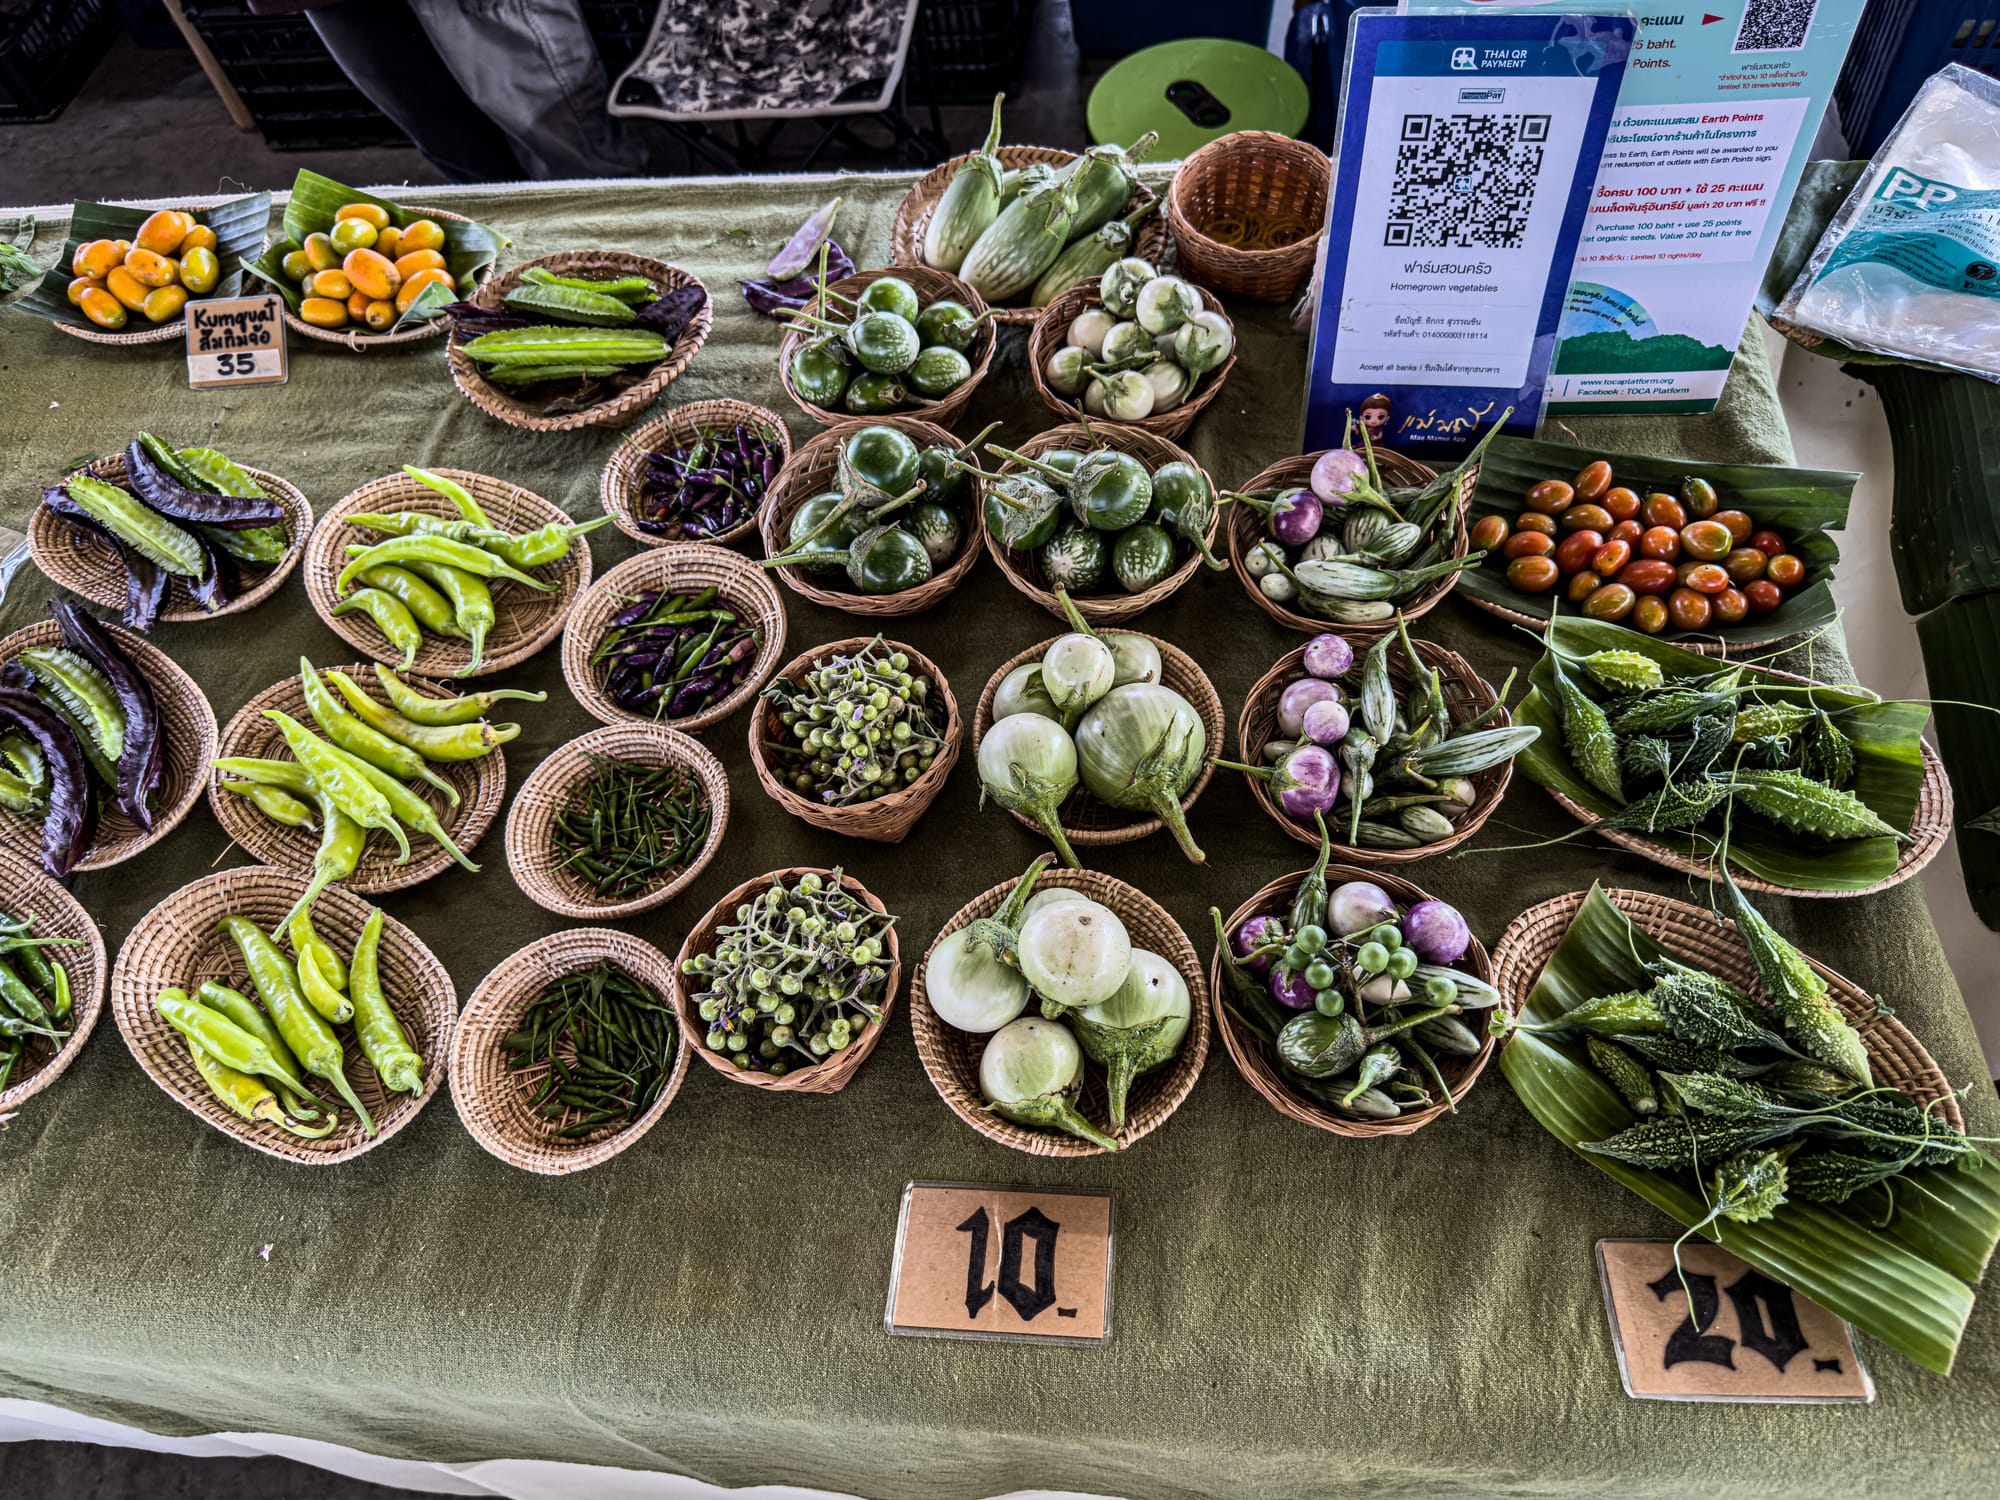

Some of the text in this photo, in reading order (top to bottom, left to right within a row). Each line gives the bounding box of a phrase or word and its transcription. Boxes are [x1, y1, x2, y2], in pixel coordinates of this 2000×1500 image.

[1647, 39, 1676, 50] baht.
[1484, 49, 1528, 60] THAI QR
[1481, 59, 1526, 68] PAYMENT
[1633, 58, 1671, 69] Points.
[1701, 114, 1730, 124] Earth
[1731, 113, 1764, 122] Points
[1764, 145, 1778, 153] you
[1636, 187, 1658, 196] 100
[1660, 187, 1682, 195] บาท
[1696, 182, 1709, 194] ใช้
[1710, 184, 1725, 193] 25
[1728, 183, 1764, 192] คะแนน
[1881, 170, 1958, 212] PP
[1745, 198, 1758, 207] ฟรี
[1715, 219, 1742, 228] points
[1597, 235, 1628, 243] organic
[1660, 232, 1684, 240] Value
[1699, 230, 1719, 238] baht
[1667, 252, 1703, 260] rights/day
[1404, 260, 1492, 275] ฟาร์มสวนครัว
[1390, 283, 1498, 293] Homegrown vegetables
[194, 299, 277, 333] Kumquat
[217, 353, 255, 376] 35
[1360, 363, 1384, 372] Accept
[1580, 378, 1675, 387] www.tocaplatform.org
